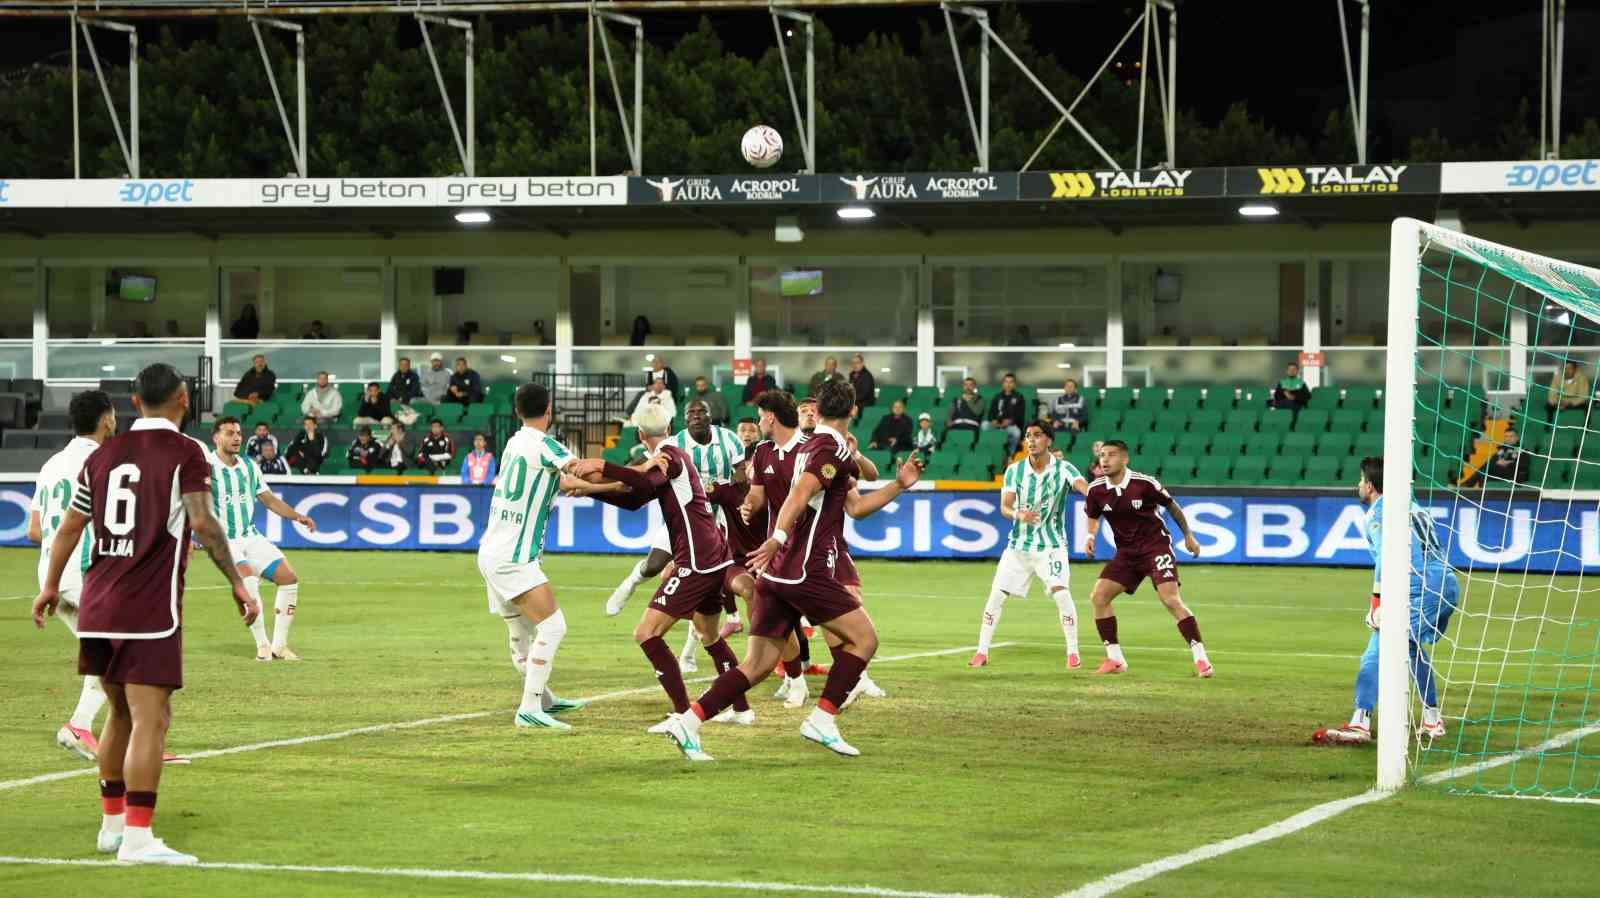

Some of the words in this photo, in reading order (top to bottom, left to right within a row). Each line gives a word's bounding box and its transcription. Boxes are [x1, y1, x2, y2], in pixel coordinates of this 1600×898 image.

[926, 176, 997, 191] ACROPOL
[1096, 170, 1192, 188] TALAY
[1305, 166, 1407, 184] TALAY
[1506, 160, 1599, 191] opet
[119, 179, 194, 206] opet
[261, 181, 331, 202] grey
[340, 179, 426, 199] beton
[447, 181, 517, 201] grey
[527, 179, 615, 198] beton
[676, 185, 722, 200] AURA
[730, 178, 799, 193] ACROPOL
[871, 183, 917, 199] AURA
[942, 189, 978, 198] BODRUM
[1100, 188, 1184, 197] LOGISTICS
[1311, 183, 1400, 193] LOGISTICS
[746, 191, 783, 200] BODRUM
[104, 463, 141, 535] 6
[1049, 560, 1062, 577] 19
[1155, 553, 1174, 571] 22
[663, 577, 681, 596] 8
